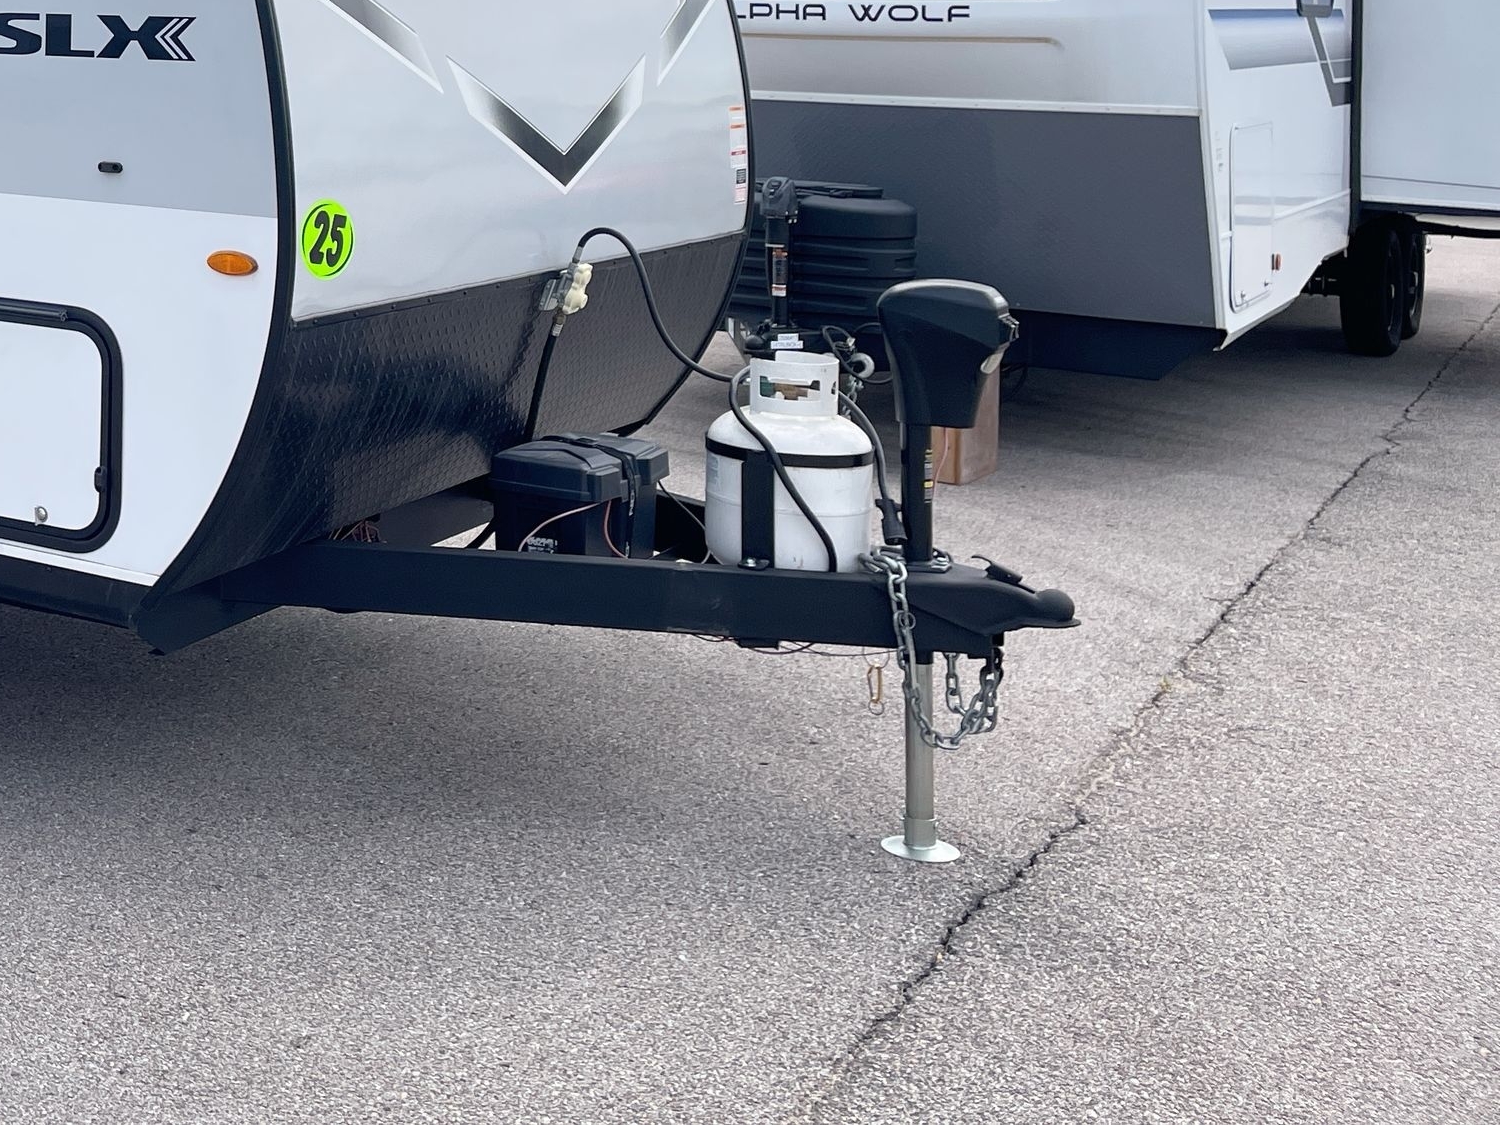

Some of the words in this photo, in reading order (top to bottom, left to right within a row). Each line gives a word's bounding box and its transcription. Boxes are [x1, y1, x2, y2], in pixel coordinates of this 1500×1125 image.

[737, 3, 827, 21] PHA
[847, 3, 971, 22] WOLF
[309, 210, 347, 268] 25
